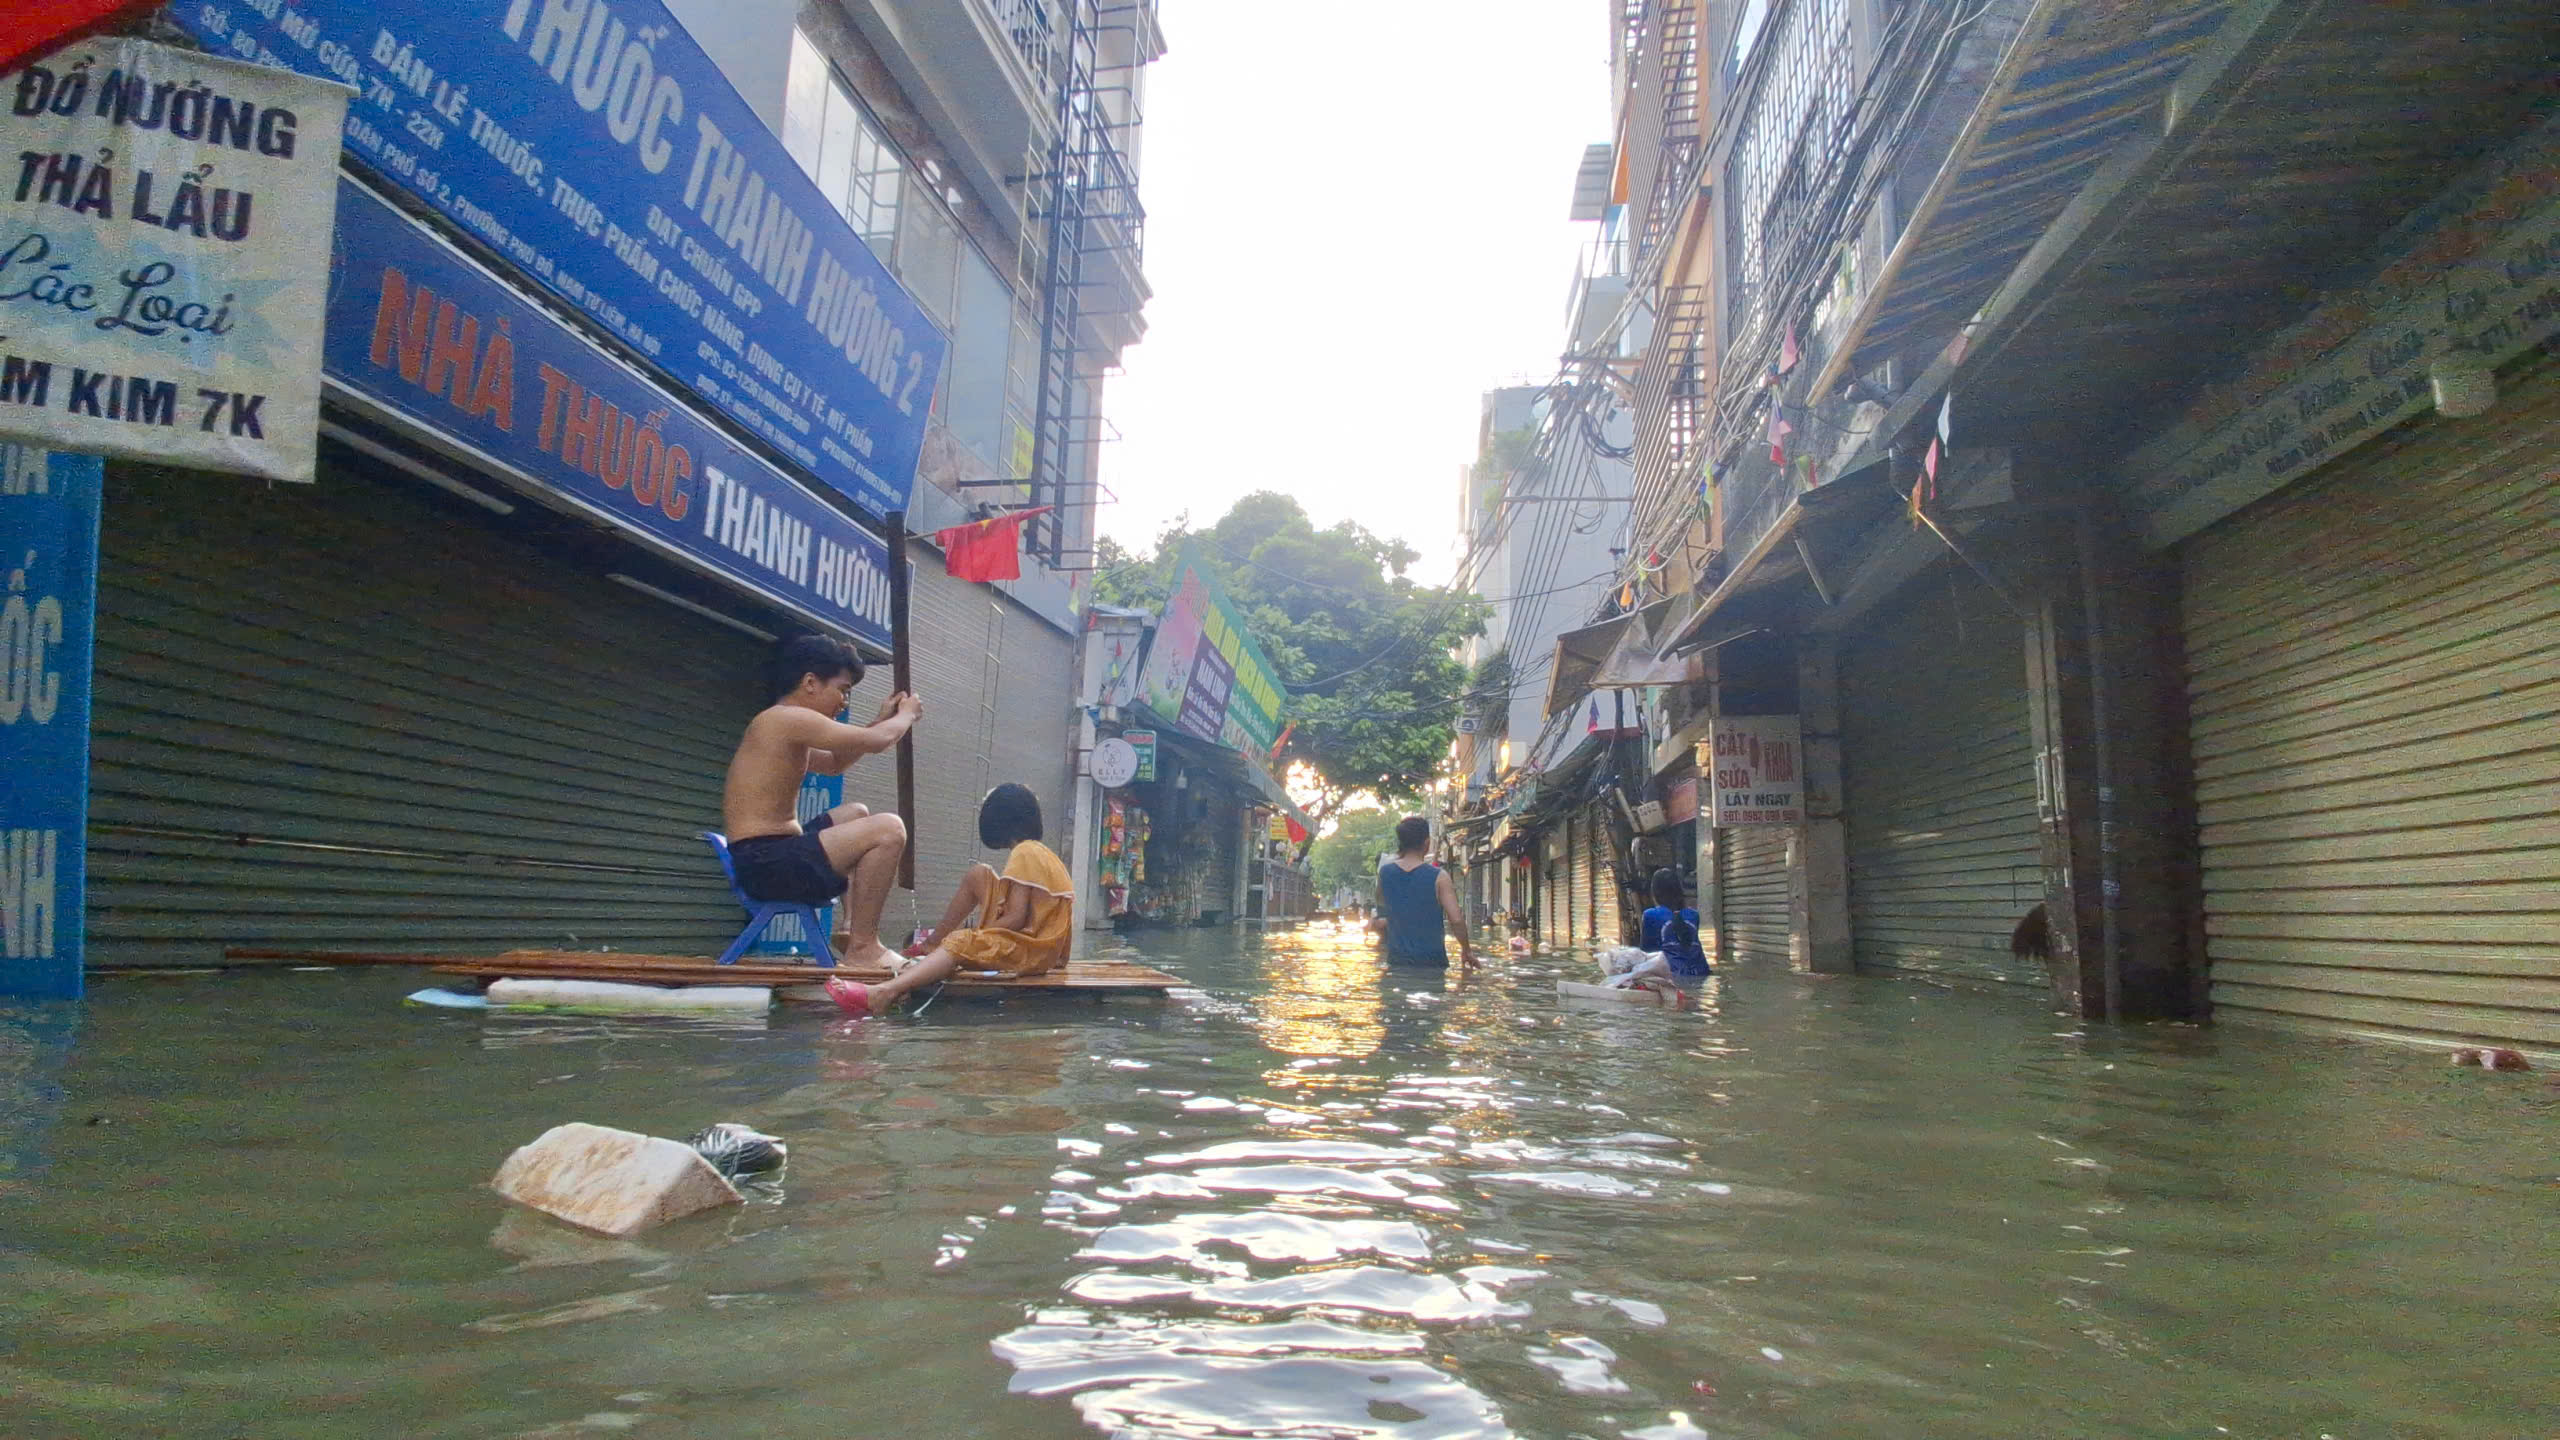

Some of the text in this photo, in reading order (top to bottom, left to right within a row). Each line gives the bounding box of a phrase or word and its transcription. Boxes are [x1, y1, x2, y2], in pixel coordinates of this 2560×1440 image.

[13, 55, 299, 161] ĐỒ NƯỚNG
[14, 148, 254, 243] THẢ LẨU
[371, 28, 434, 97] BÁN
[432, 79, 470, 126] LẺ
[551, 176, 604, 237] THỰC
[658, 269, 703, 320] CHỨC
[95, 261, 236, 344] Loại
[683, 112, 814, 306] THANH
[897, 352, 922, 417] 2
[732, 282, 764, 318] GPP
[0, 354, 268, 440] M KIM 7K
[370, 266, 513, 430] NHÀ
[539, 362, 694, 522] THUỐC
[703, 464, 809, 586] THANH
[0, 549, 63, 726] ỐC
